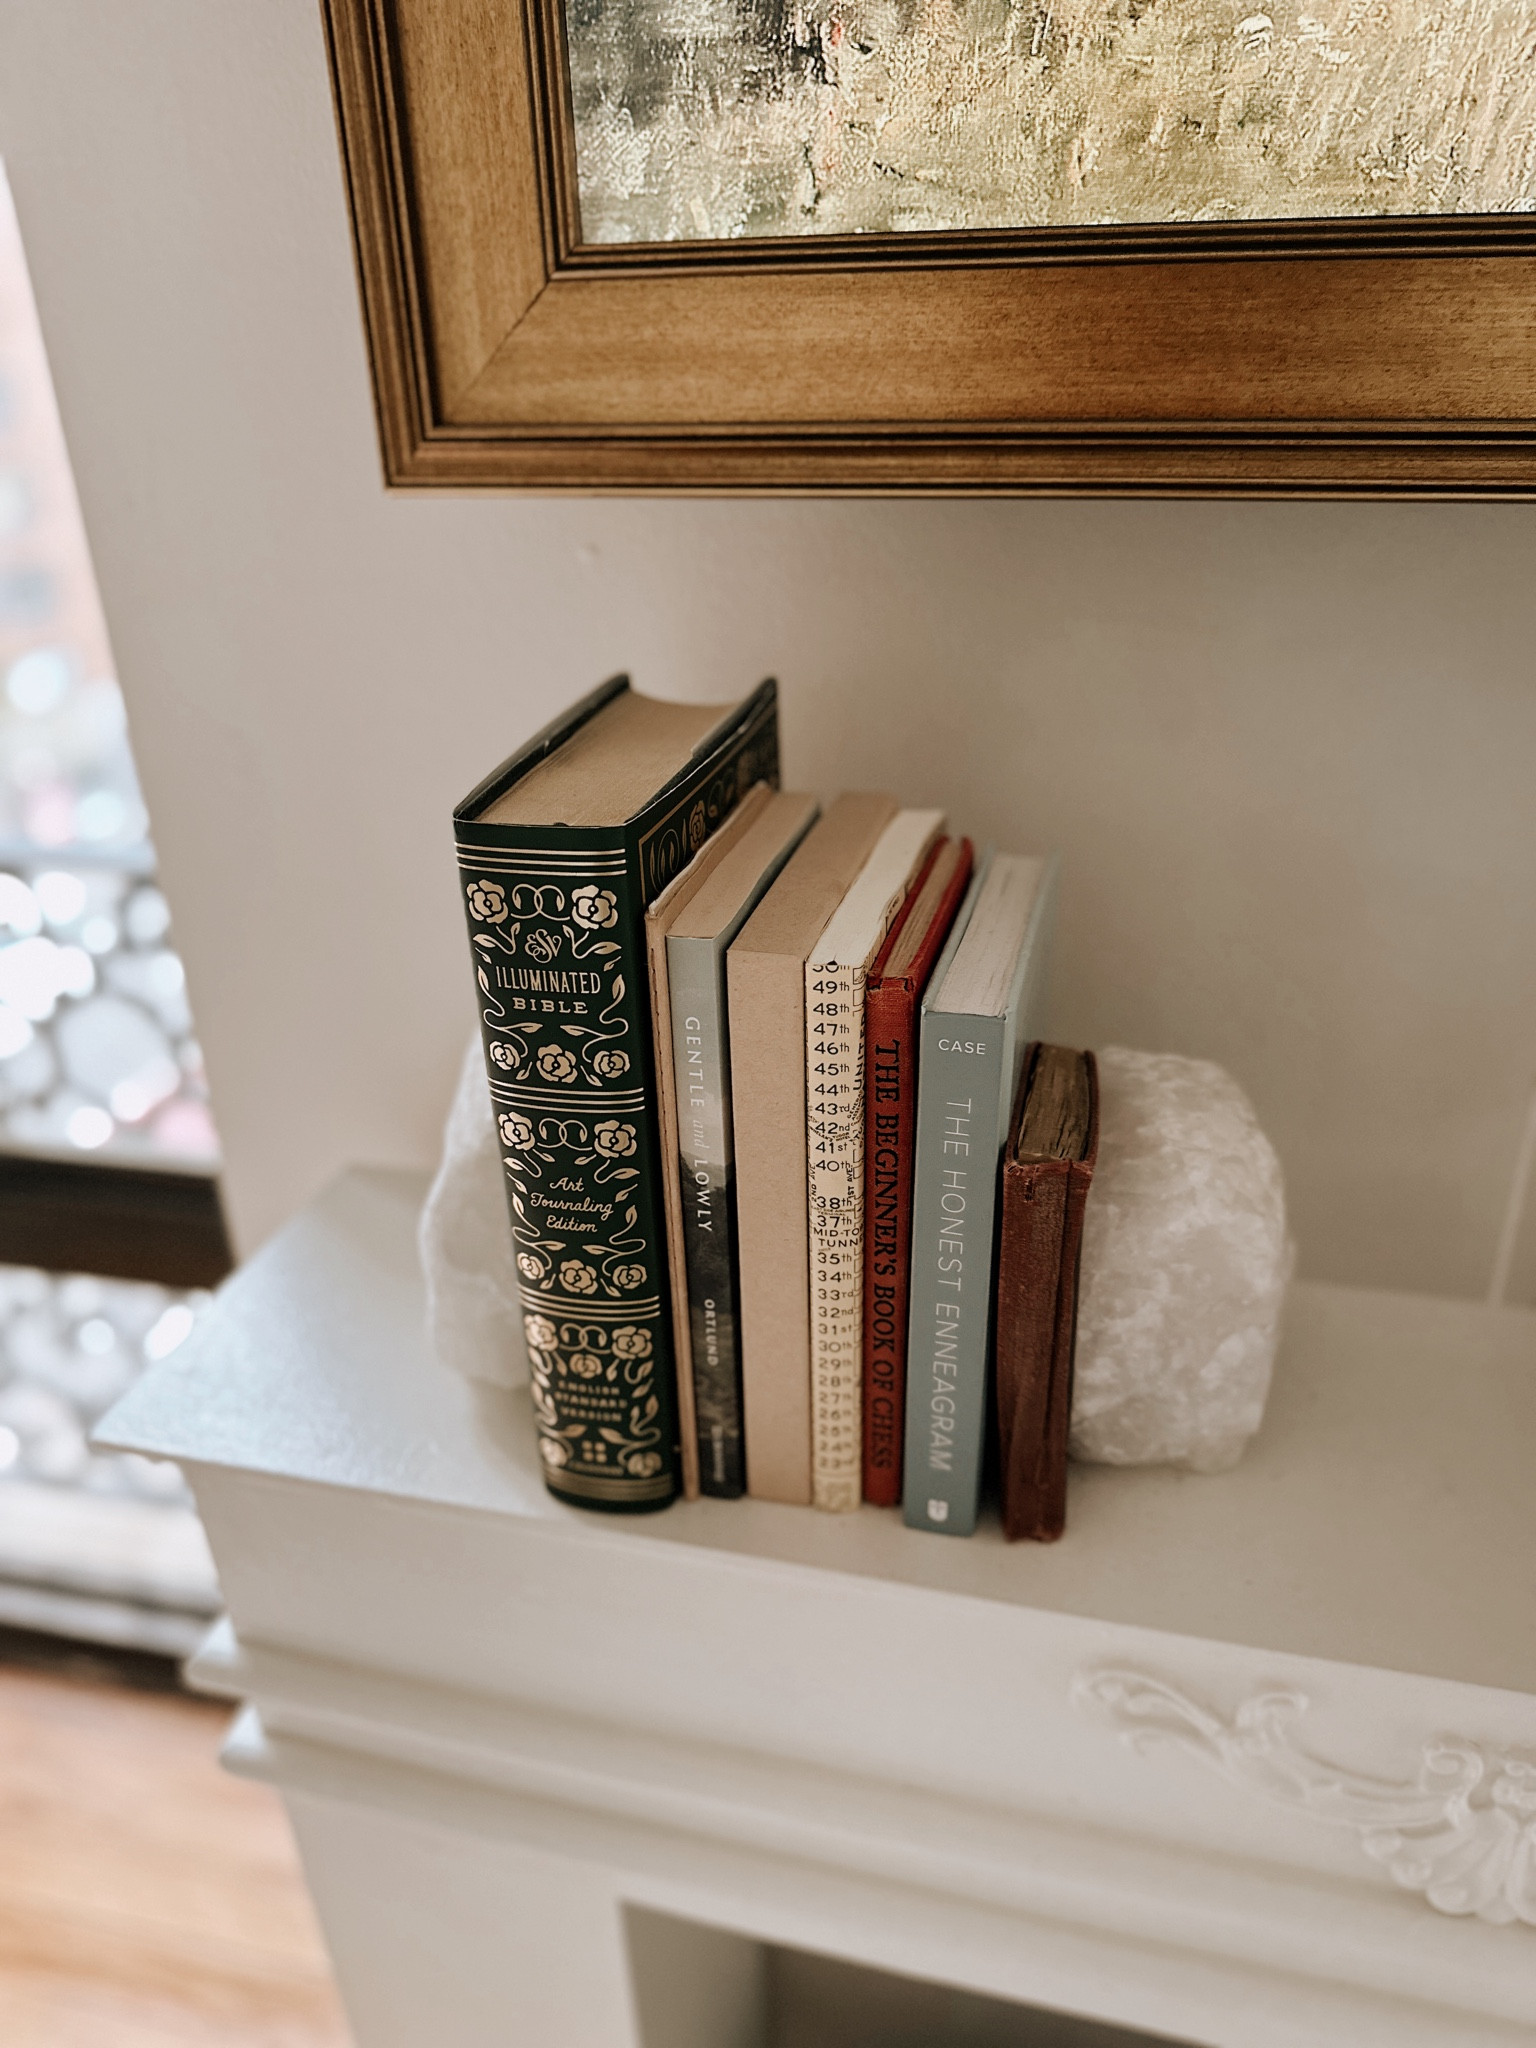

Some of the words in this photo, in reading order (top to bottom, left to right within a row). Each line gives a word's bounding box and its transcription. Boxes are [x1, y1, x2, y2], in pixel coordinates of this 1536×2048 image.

[524, 928, 562, 963] ESV
[495, 965, 600, 994] ILLUMINATED
[812, 980, 850, 994] 49th
[512, 997, 588, 1014] BIBLE
[812, 1003, 850, 1016] 48th
[813, 1022, 850, 1036] 47th
[814, 1041, 850, 1055] 46th
[938, 1039, 986, 1055] CASE
[685, 1016, 705, 1107] GENTLE
[814, 1062, 850, 1076] 45th
[875, 1039, 900, 1103] THE
[814, 1083, 850, 1096] 44th
[815, 1102, 850, 1115] 43rd
[693, 1119, 710, 1149] and
[815, 1121, 850, 1135] 42nd
[943, 1098, 971, 1156] THE
[815, 1141, 848, 1154] 41st
[815, 1159, 852, 1172] 40th
[550, 1177, 585, 1192] Art
[694, 1159, 713, 1232] LOWLY
[874, 1112, 899, 1276] BEGINNER'S
[530, 1192, 614, 1221] Journaling
[816, 1196, 853, 1210] 38th
[546, 1215, 598, 1232] Edition
[817, 1215, 853, 1228] 37th
[937, 1169, 967, 1291] HONEST
[817, 1252, 853, 1265] 35th
[817, 1270, 853, 1283] 34th
[818, 1288, 854, 1301] 33rd
[818, 1306, 854, 1319] 32nd
[872, 1283, 896, 1352] BOOK
[704, 1299, 719, 1366] ORTLUND
[818, 1323, 853, 1335] 31st
[818, 1341, 853, 1353] 30th
[872, 1360, 894, 1392] OF
[929, 1303, 960, 1471] ENNEAGRAM
[871, 1397, 894, 1468] CHESS
